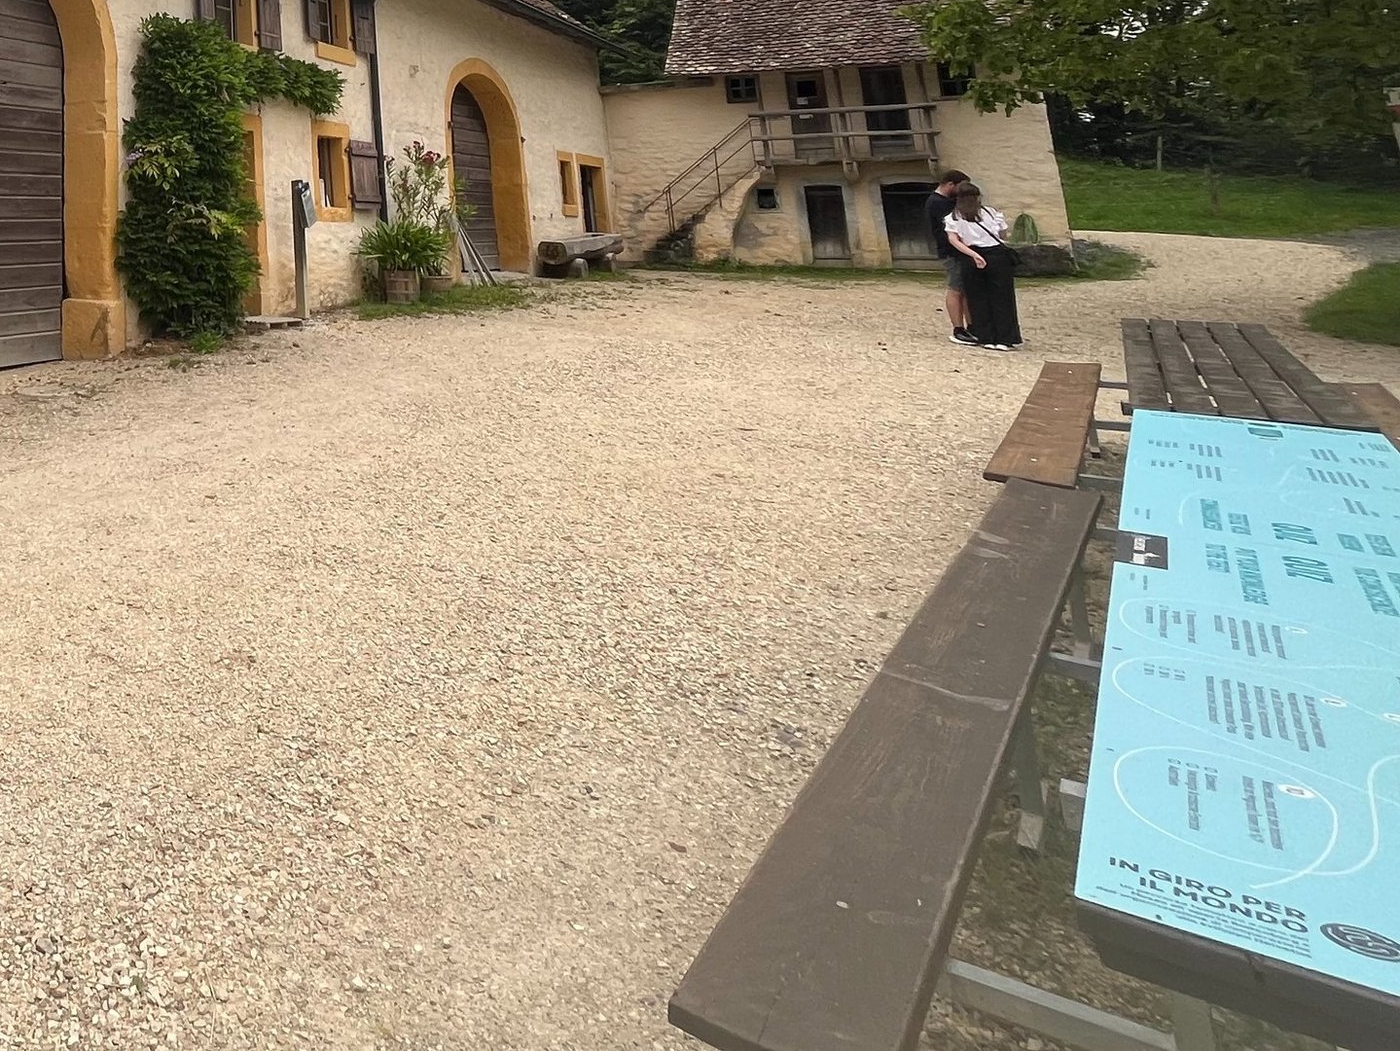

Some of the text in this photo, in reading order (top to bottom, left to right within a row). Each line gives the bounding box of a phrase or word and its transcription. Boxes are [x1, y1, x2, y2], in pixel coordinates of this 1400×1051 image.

[1271, 522, 1318, 545] QUIZ
[1281, 555, 1334, 584] QUIZ
[1109, 856, 1139, 873] IN
[1149, 869, 1232, 899] GIRO
[1242, 894, 1306, 921] PER
[1140, 876, 1164, 893] IL
[1174, 886, 1308, 934] MONDO
